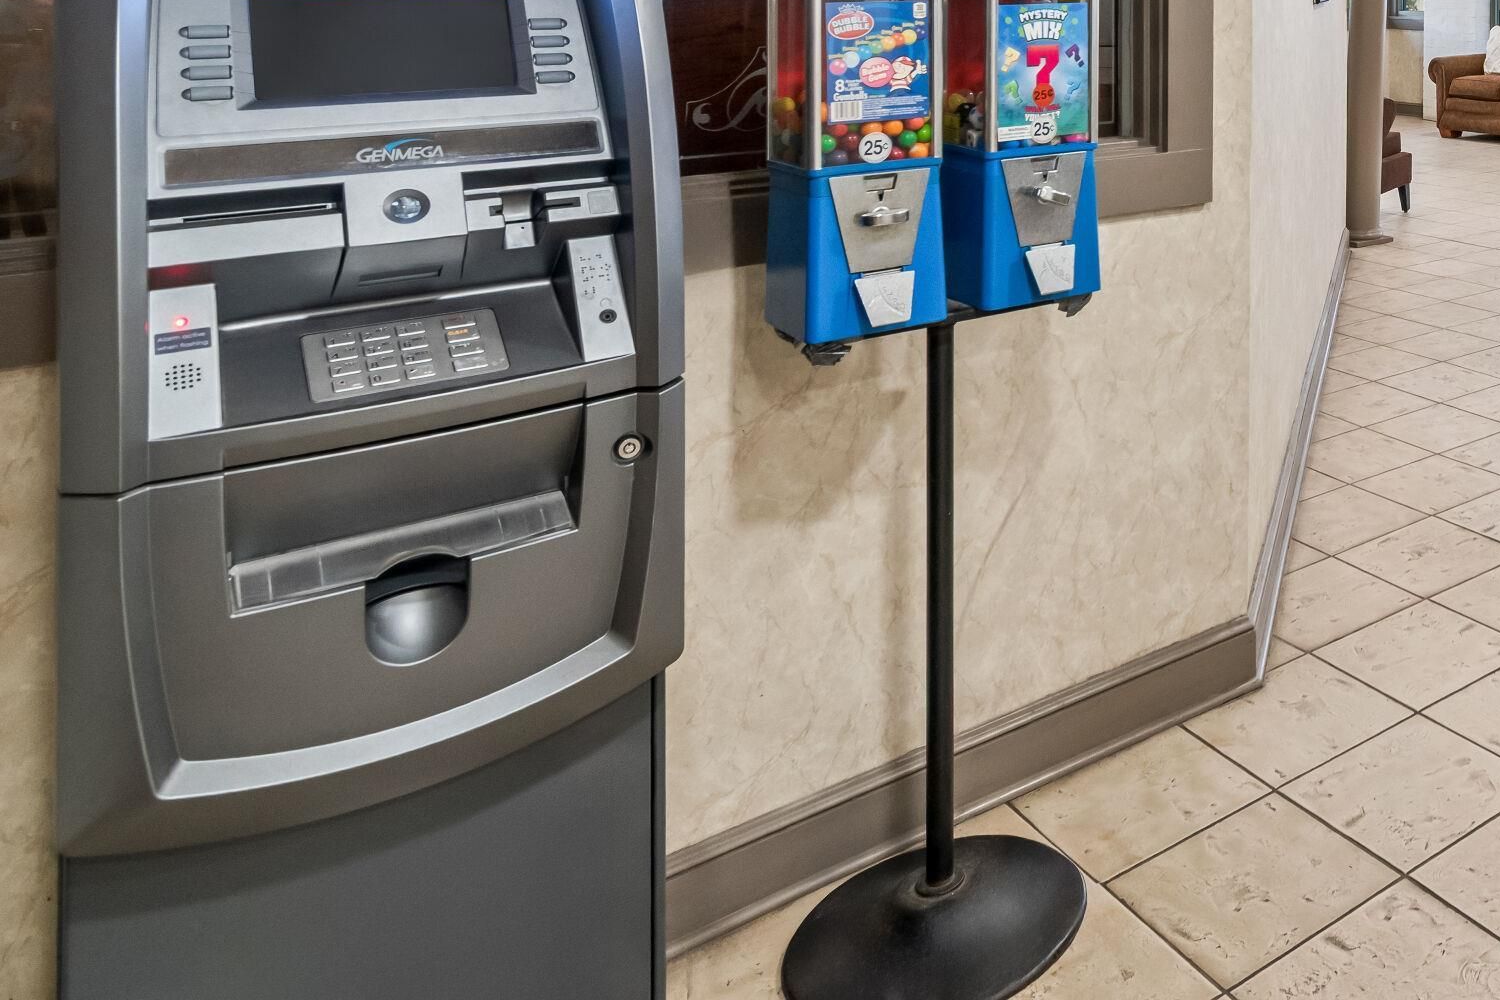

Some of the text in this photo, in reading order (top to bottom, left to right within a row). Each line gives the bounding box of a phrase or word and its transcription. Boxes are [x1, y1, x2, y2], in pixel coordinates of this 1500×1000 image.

[831, 16, 869, 28] DUBBLE
[1019, 9, 1068, 23] MYSTERY
[833, 23, 870, 35] BUBBLE
[1023, 20, 1063, 41] MIX
[835, 79, 845, 93] 8
[355, 144, 445, 164] GENMEGA
